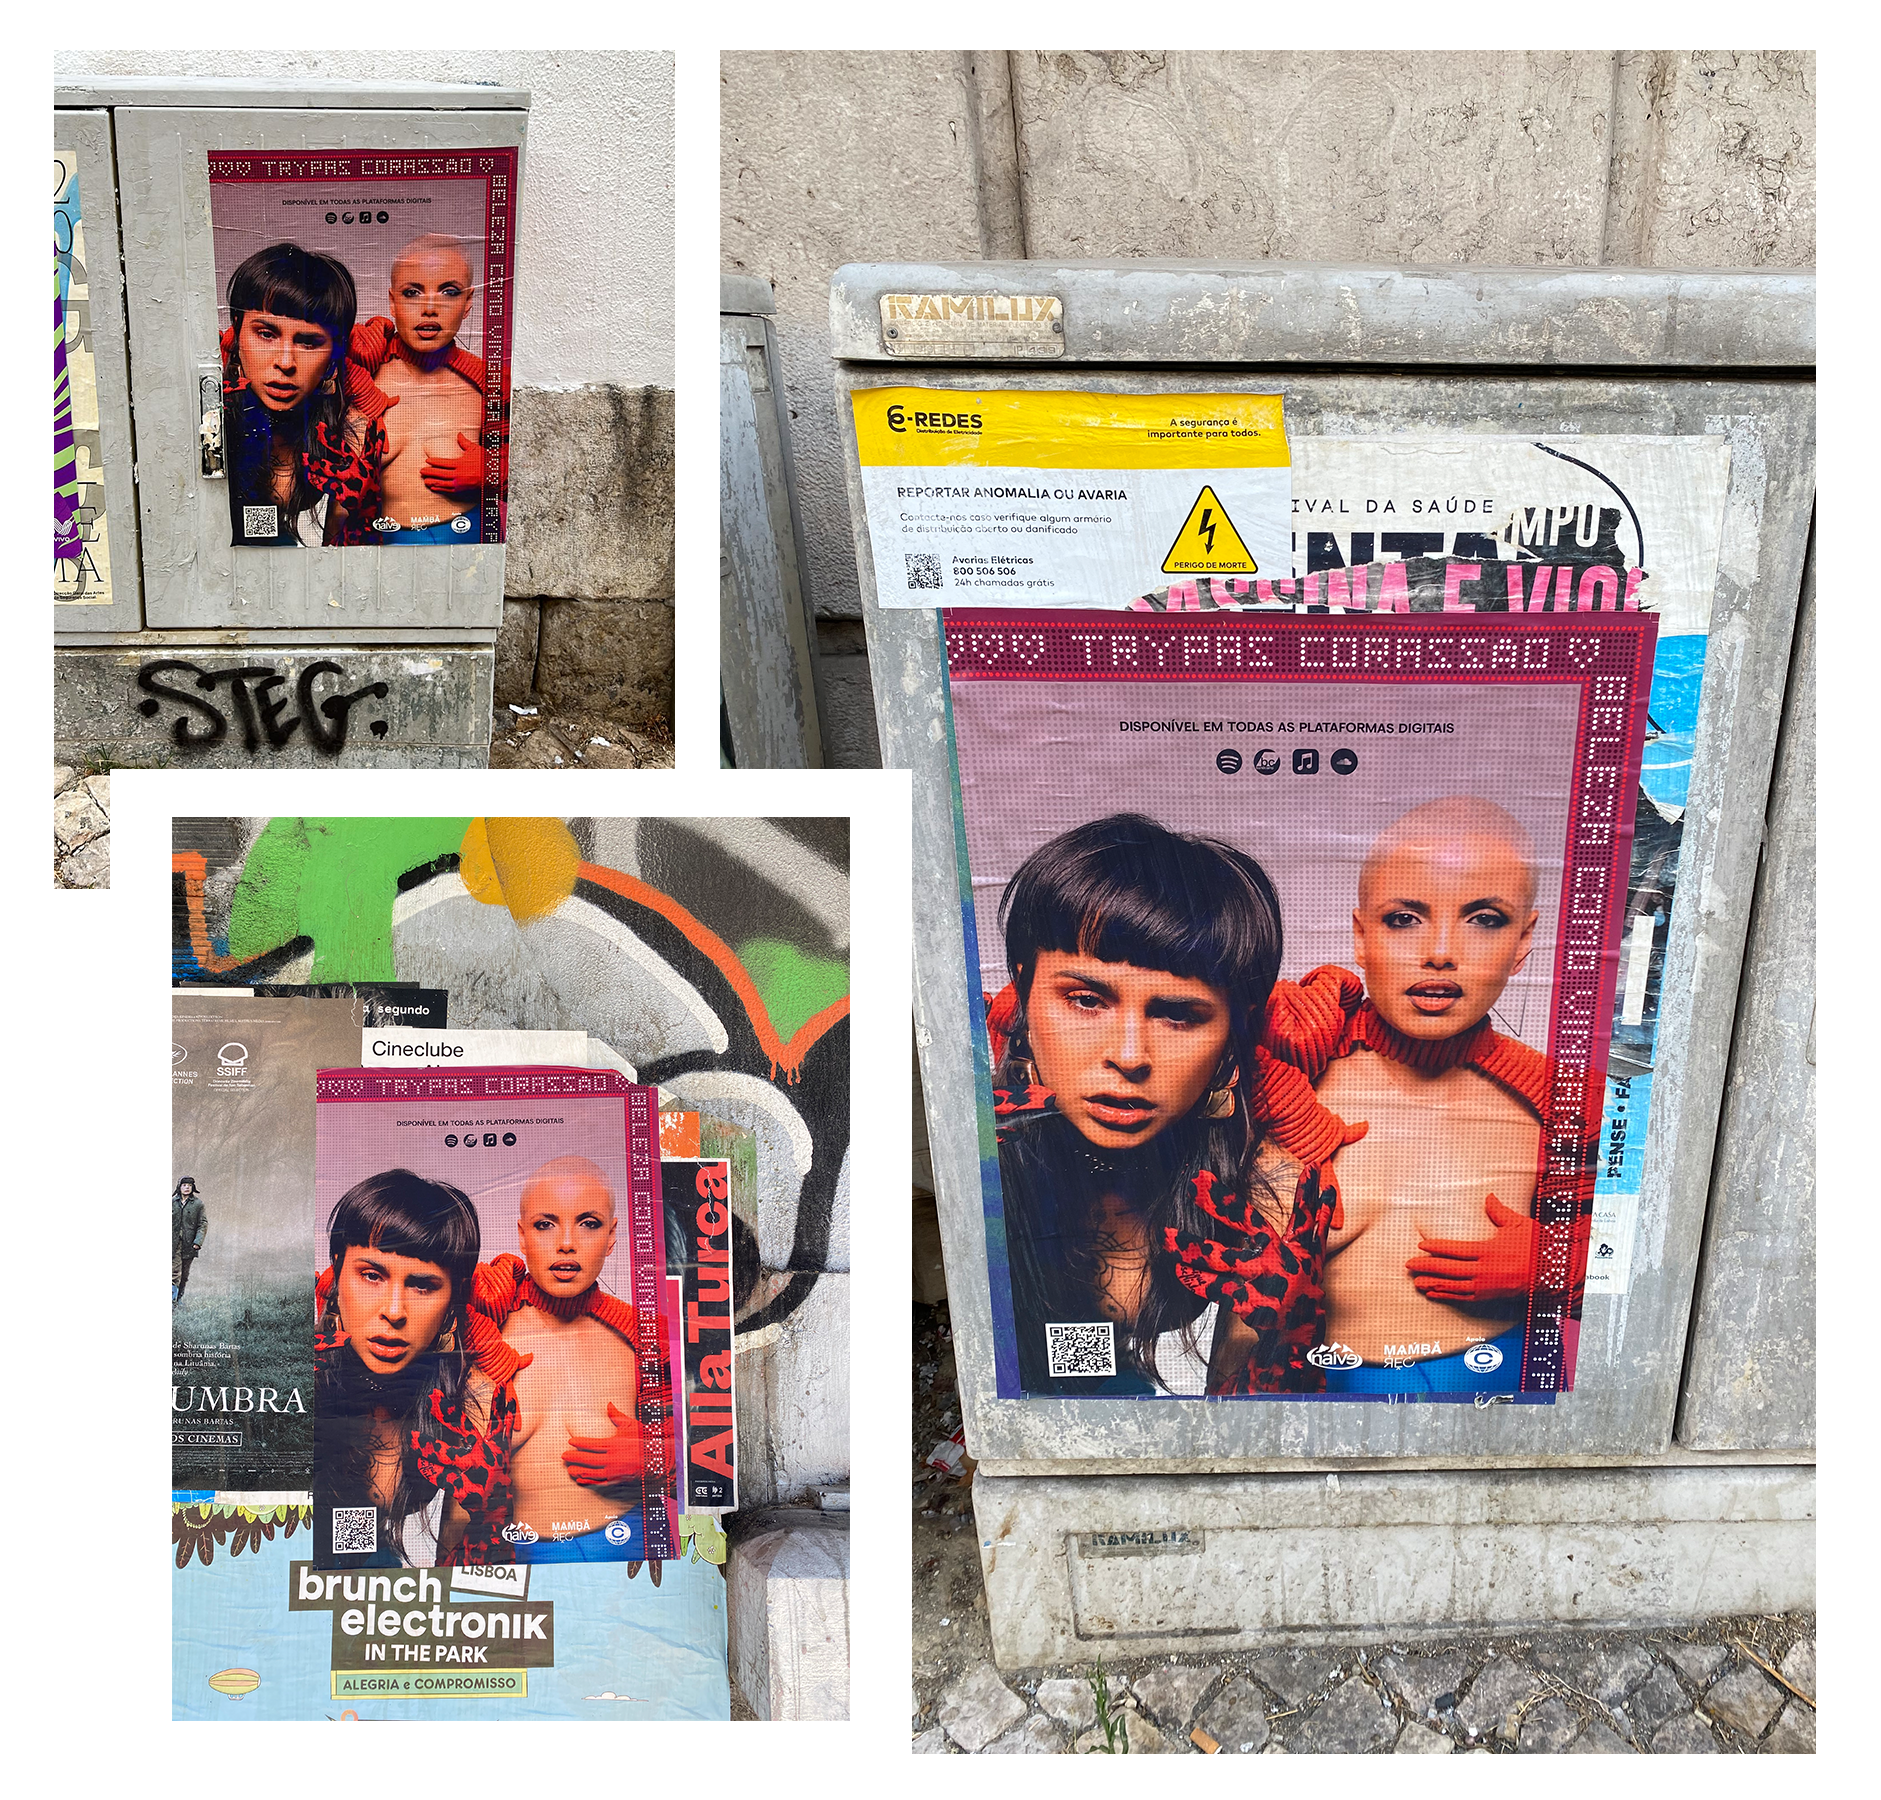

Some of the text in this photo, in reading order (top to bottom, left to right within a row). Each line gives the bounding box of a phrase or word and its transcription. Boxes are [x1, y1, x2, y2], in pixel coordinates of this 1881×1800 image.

[262, 160, 351, 176] TRYPAS
[490, 175, 507, 254] BELEZA
[489, 264, 504, 316] COMO
[888, 295, 1056, 321] RAMILUX
[1169, 417, 1238, 429] A segurança é
[1147, 429, 1261, 440] importante para todos.
[897, 487, 1128, 500] REPORTAR ANOMALIA OU AVARIA
[1366, 499, 1396, 513] DA
[1412, 496, 1494, 513] SAÚDE
[994, 512, 1037, 524] verifique
[1039, 513, 1071, 524] algum
[901, 524, 914, 533] de
[1025, 525, 1078, 535] danificado
[952, 555, 1034, 565] Avarias Elétricas
[1174, 561, 1247, 569] PERIGO DE MORTE
[953, 567, 1017, 576] 800 506 506
[954, 578, 1055, 589] 24h chamadas grátis
[1071, 635, 1274, 667] TRYPAS
[1119, 718, 1455, 734] DISPONÍVEL EM TODAS AS PLATAFORMAS DIGITAIS
[1579, 676, 1627, 845] BELEZA
[1567, 866, 1606, 970] COMO
[377, 1004, 431, 1016] segundo
[372, 1040, 464, 1058] Cineclube
[216, 1067, 248, 1076] SSIFF
[375, 1078, 473, 1095] TRYPAS
[486, 1118, 534, 1126] PLATAFORMAS
[630, 1092, 649, 1181] BELEZA
[1606, 1118, 1628, 1178] PENSE
[633, 1191, 653, 1253] COMO
[687, 1162, 734, 1343] Turca
[1531, 1304, 1562, 1390] TRYP
[172, 1386, 307, 1413] UMBRA
[690, 1349, 735, 1480] Alla
[187, 1435, 239, 1444] CINEMAS
[648, 1486, 668, 1558] TRYP
[461, 1565, 518, 1582] LISBOA
[298, 1566, 442, 1603] brunch
[364, 1643, 489, 1663] IN THE PARK
[343, 1677, 517, 1690] ALEGRIA e COMPROMISSO
